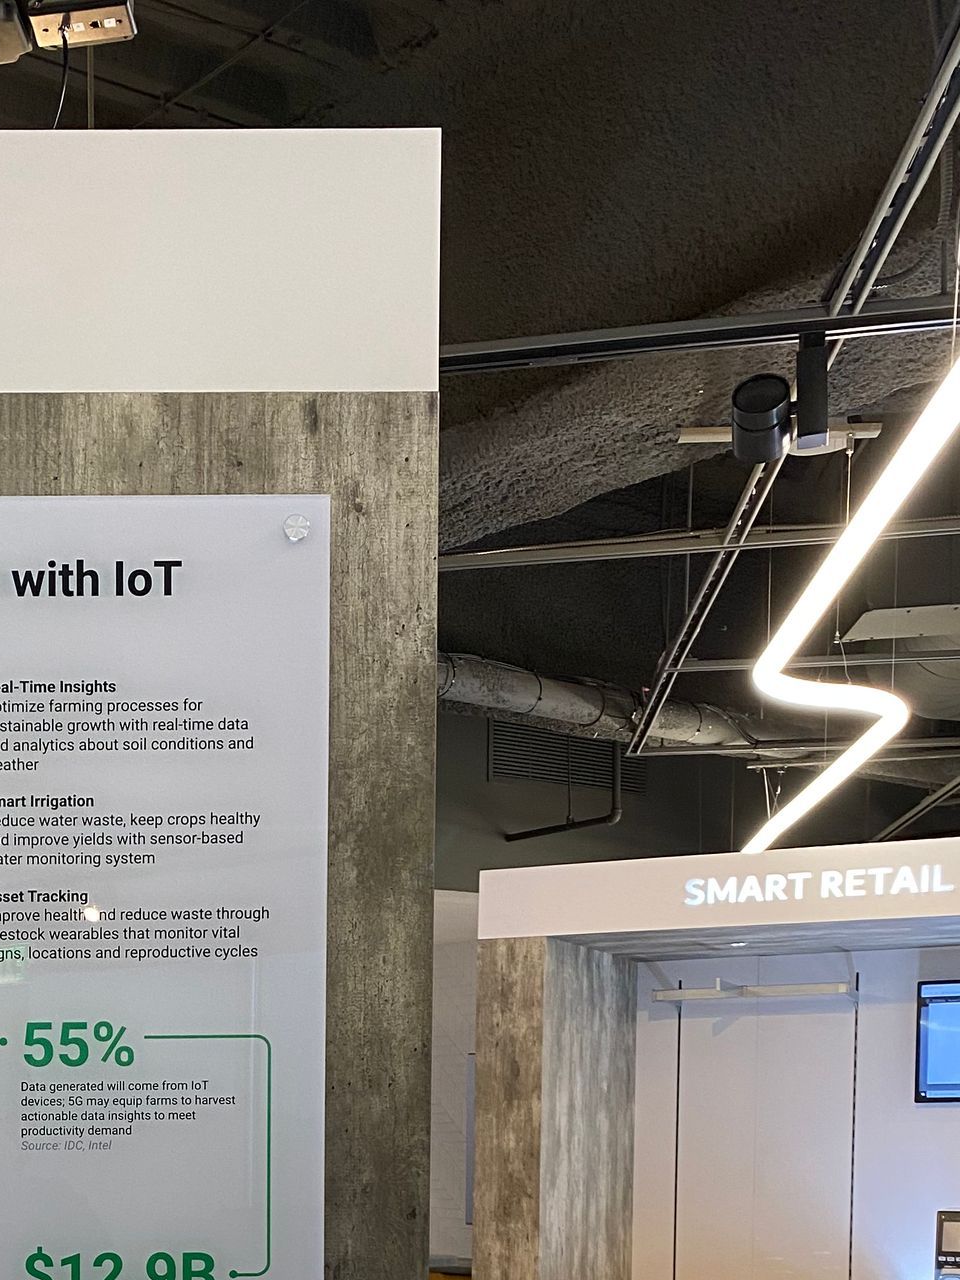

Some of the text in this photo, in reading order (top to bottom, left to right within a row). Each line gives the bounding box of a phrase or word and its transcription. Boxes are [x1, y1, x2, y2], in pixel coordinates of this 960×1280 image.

[11, 559, 100, 598] with
[115, 560, 183, 597] IoT
[59, 679, 117, 696] Insights
[48, 698, 103, 716] farming
[107, 701, 179, 716] processes
[182, 697, 204, 712] for
[67, 717, 116, 735] growth
[118, 717, 149, 732] with
[152, 717, 214, 731] real-time
[217, 716, 249, 731] data
[12, 737, 75, 755] analytics
[78, 737, 119, 752] about
[122, 737, 147, 751] soil
[151, 736, 224, 751] conditions
[227, 735, 254, 750] and
[30, 793, 95, 811] Irrigation
[38, 814, 79, 827] water
[81, 814, 127, 828] waste,
[130, 812, 164, 829] keep
[167, 814, 206, 829] crops
[210, 811, 261, 828] healthy
[13, 833, 70, 850] improve
[72, 831, 113, 849] yields
[116, 831, 146, 846] with
[149, 830, 244, 845] sensor-based
[26, 851, 101, 868] monitoring
[105, 852, 156, 868] system
[683, 864, 954, 906] SMART RETAIL
[27, 889, 88, 906] Tracking
[44, 907, 86, 922] health
[90, 907, 116, 921] nd
[120, 907, 168, 921] reduce
[170, 908, 213, 921] waste
[215, 905, 270, 923] through
[48, 926, 120, 941] wearables
[122, 926, 150, 940] that
[154, 926, 209, 940] monitor
[211, 925, 240, 939] vital
[28, 946, 92, 960] locations
[95, 945, 121, 959] and
[124, 944, 211, 962] reproductive
[214, 944, 259, 961] cycles
[23, 1020, 135, 1068] 55%
[20, 1079, 209, 1094] Data generated will come from IoT
[20, 1094, 236, 1109] devices; 5G may equip farms to harvest
[20, 1109, 196, 1124] actionable data insights to meet
[20, 1124, 132, 1139] productivity demand
[20, 1139, 113, 1152] Source: IDC, Intel
